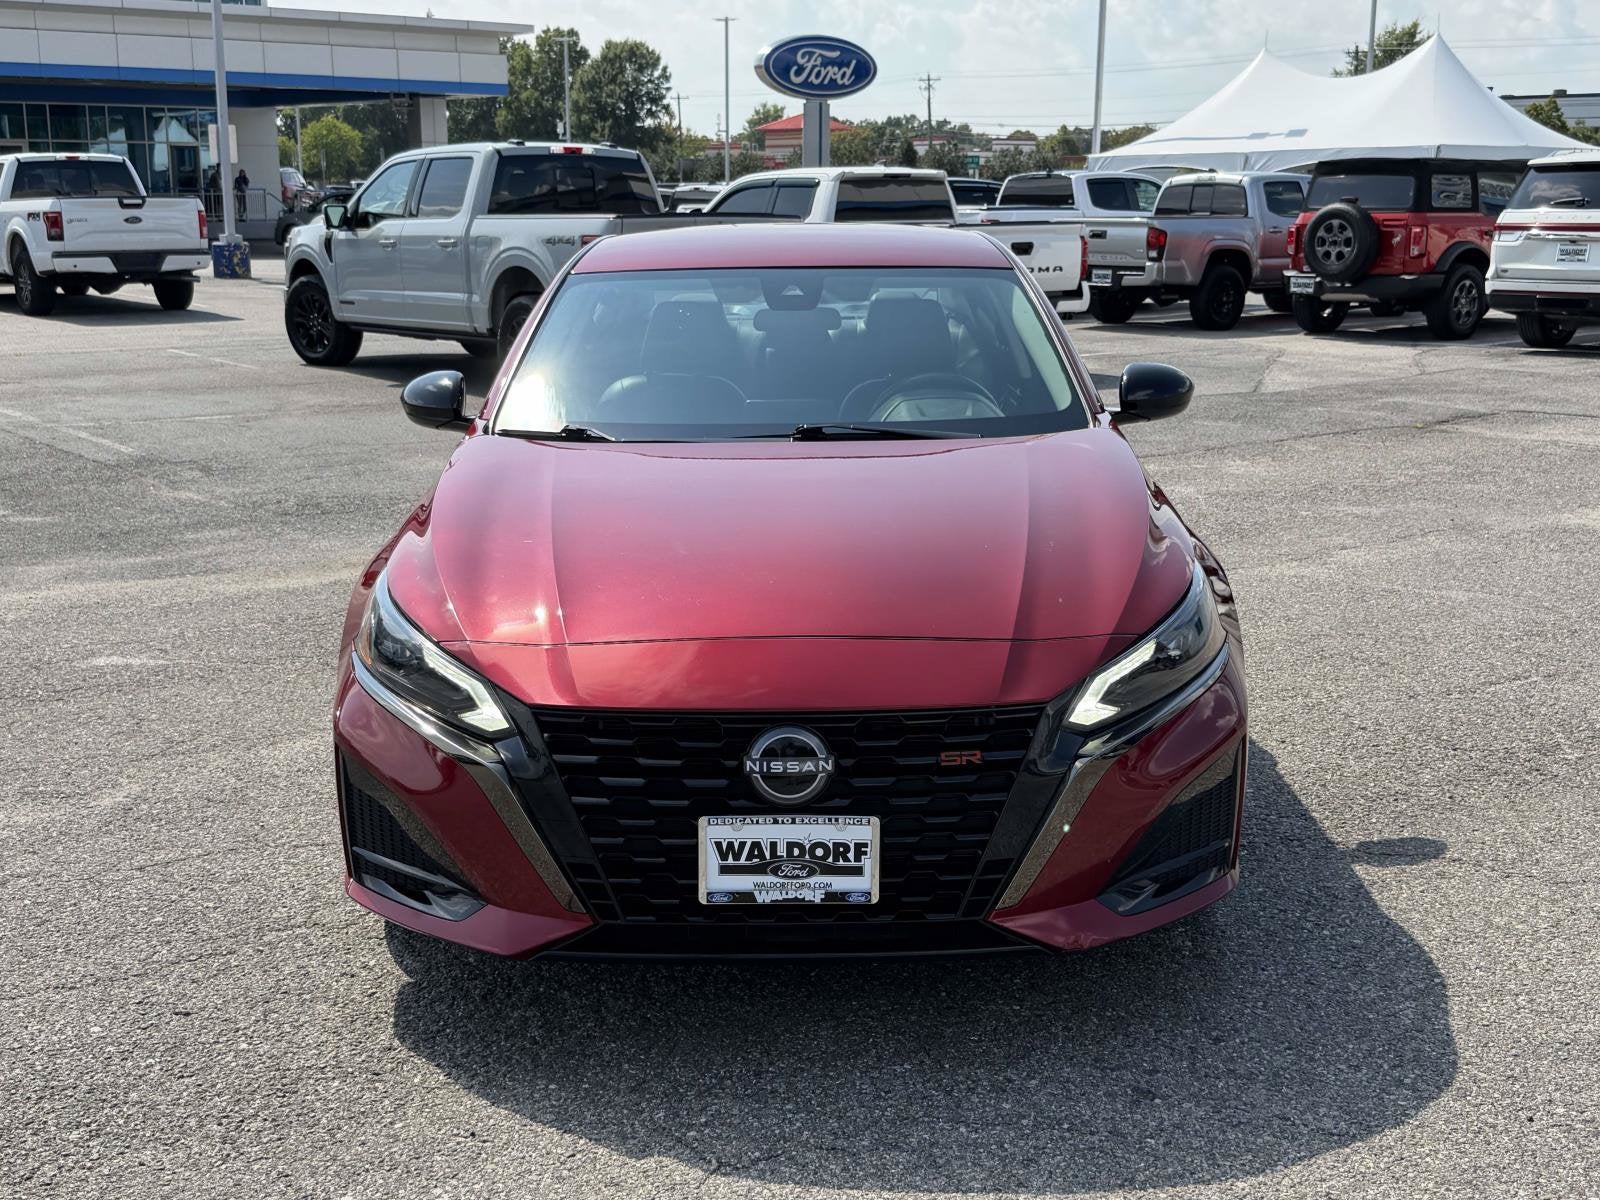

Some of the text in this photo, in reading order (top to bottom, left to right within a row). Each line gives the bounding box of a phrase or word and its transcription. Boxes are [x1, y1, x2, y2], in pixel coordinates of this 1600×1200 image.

[789, 48, 857, 85] Ford
[940, 750, 983, 766] SR
[746, 760, 832, 773] NISSAN
[709, 817, 870, 825] DEDICATED TO EXCELLENCE
[711, 839, 871, 864] WALDORF
[777, 863, 809, 878] Ford
[752, 881, 833, 890] WALDORFFORD.COM
[712, 892, 729, 902] Ford
[753, 888, 827, 904] WALDORF
[849, 892, 867, 902] Ford
